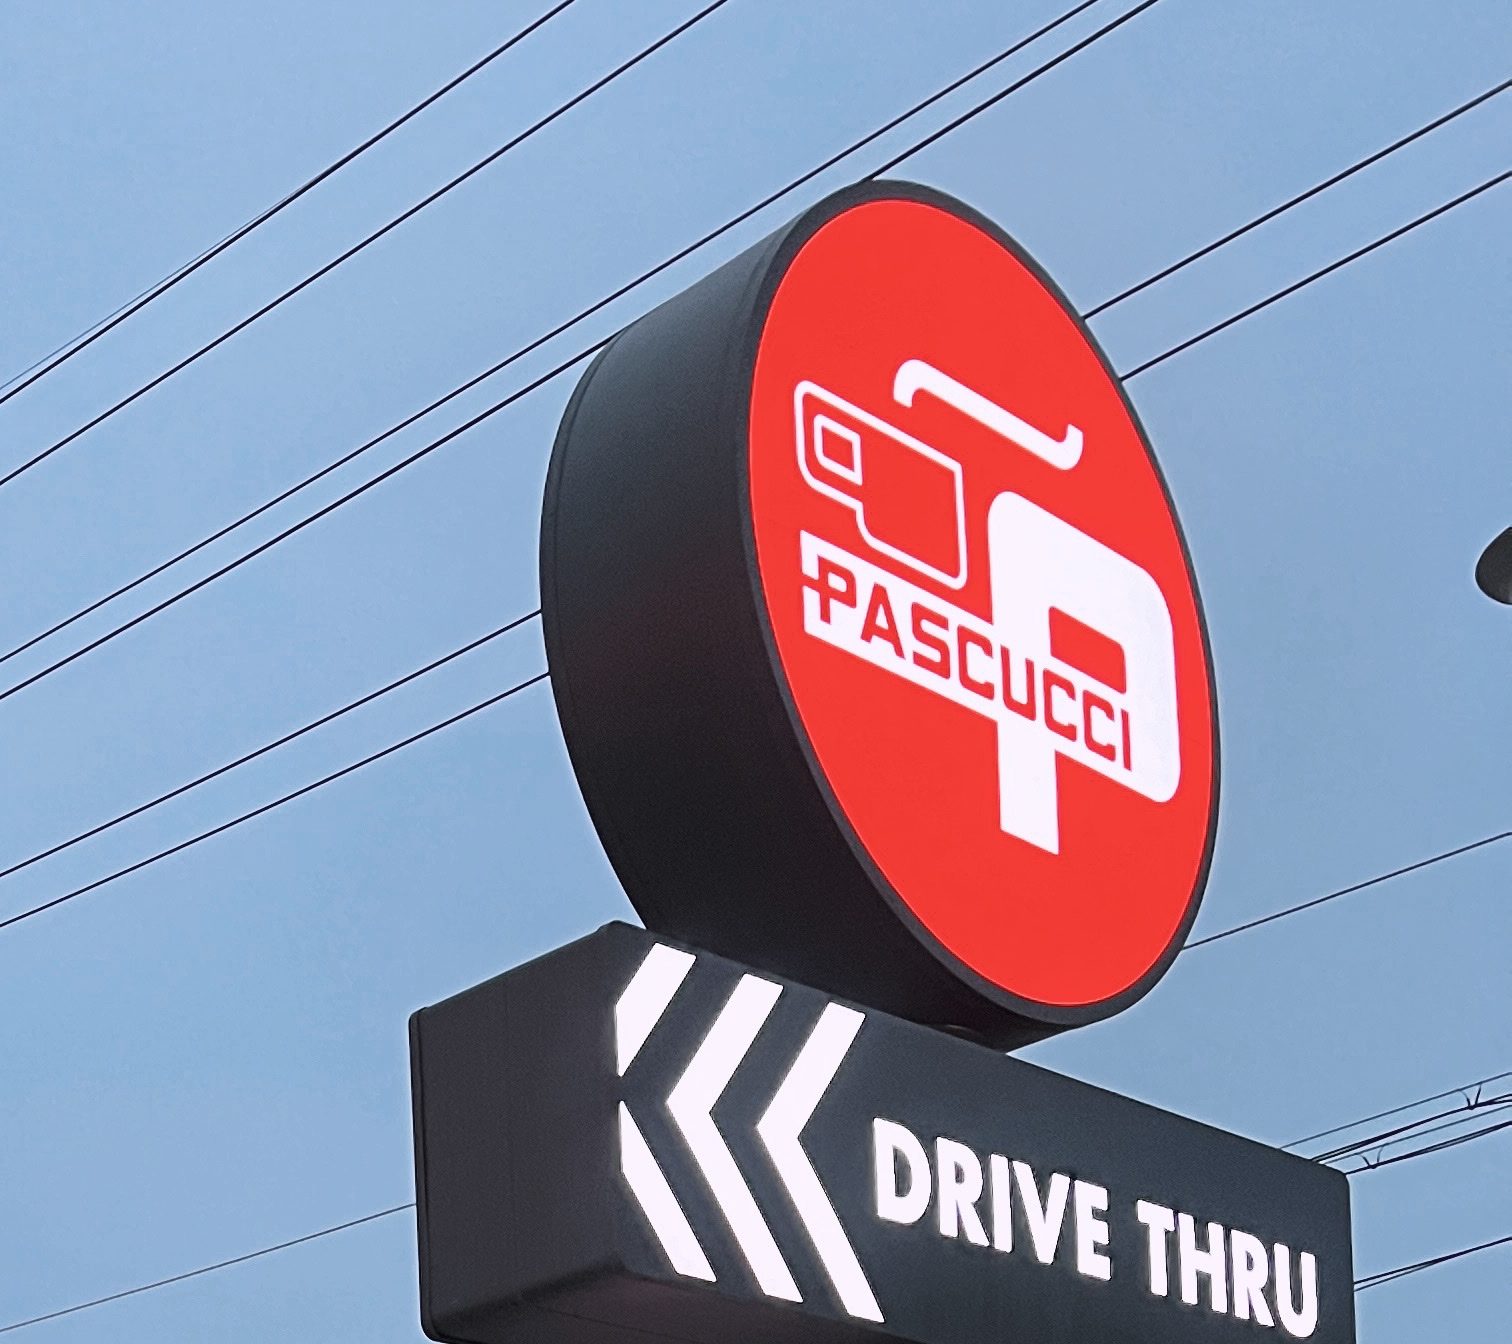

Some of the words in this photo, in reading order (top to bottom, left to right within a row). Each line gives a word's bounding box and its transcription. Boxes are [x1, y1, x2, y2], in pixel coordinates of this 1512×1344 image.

[801, 554, 1134, 773] PASCUCCI
[872, 1116, 1112, 1282] DRIVE
[1135, 1198, 1321, 1340] THRU
